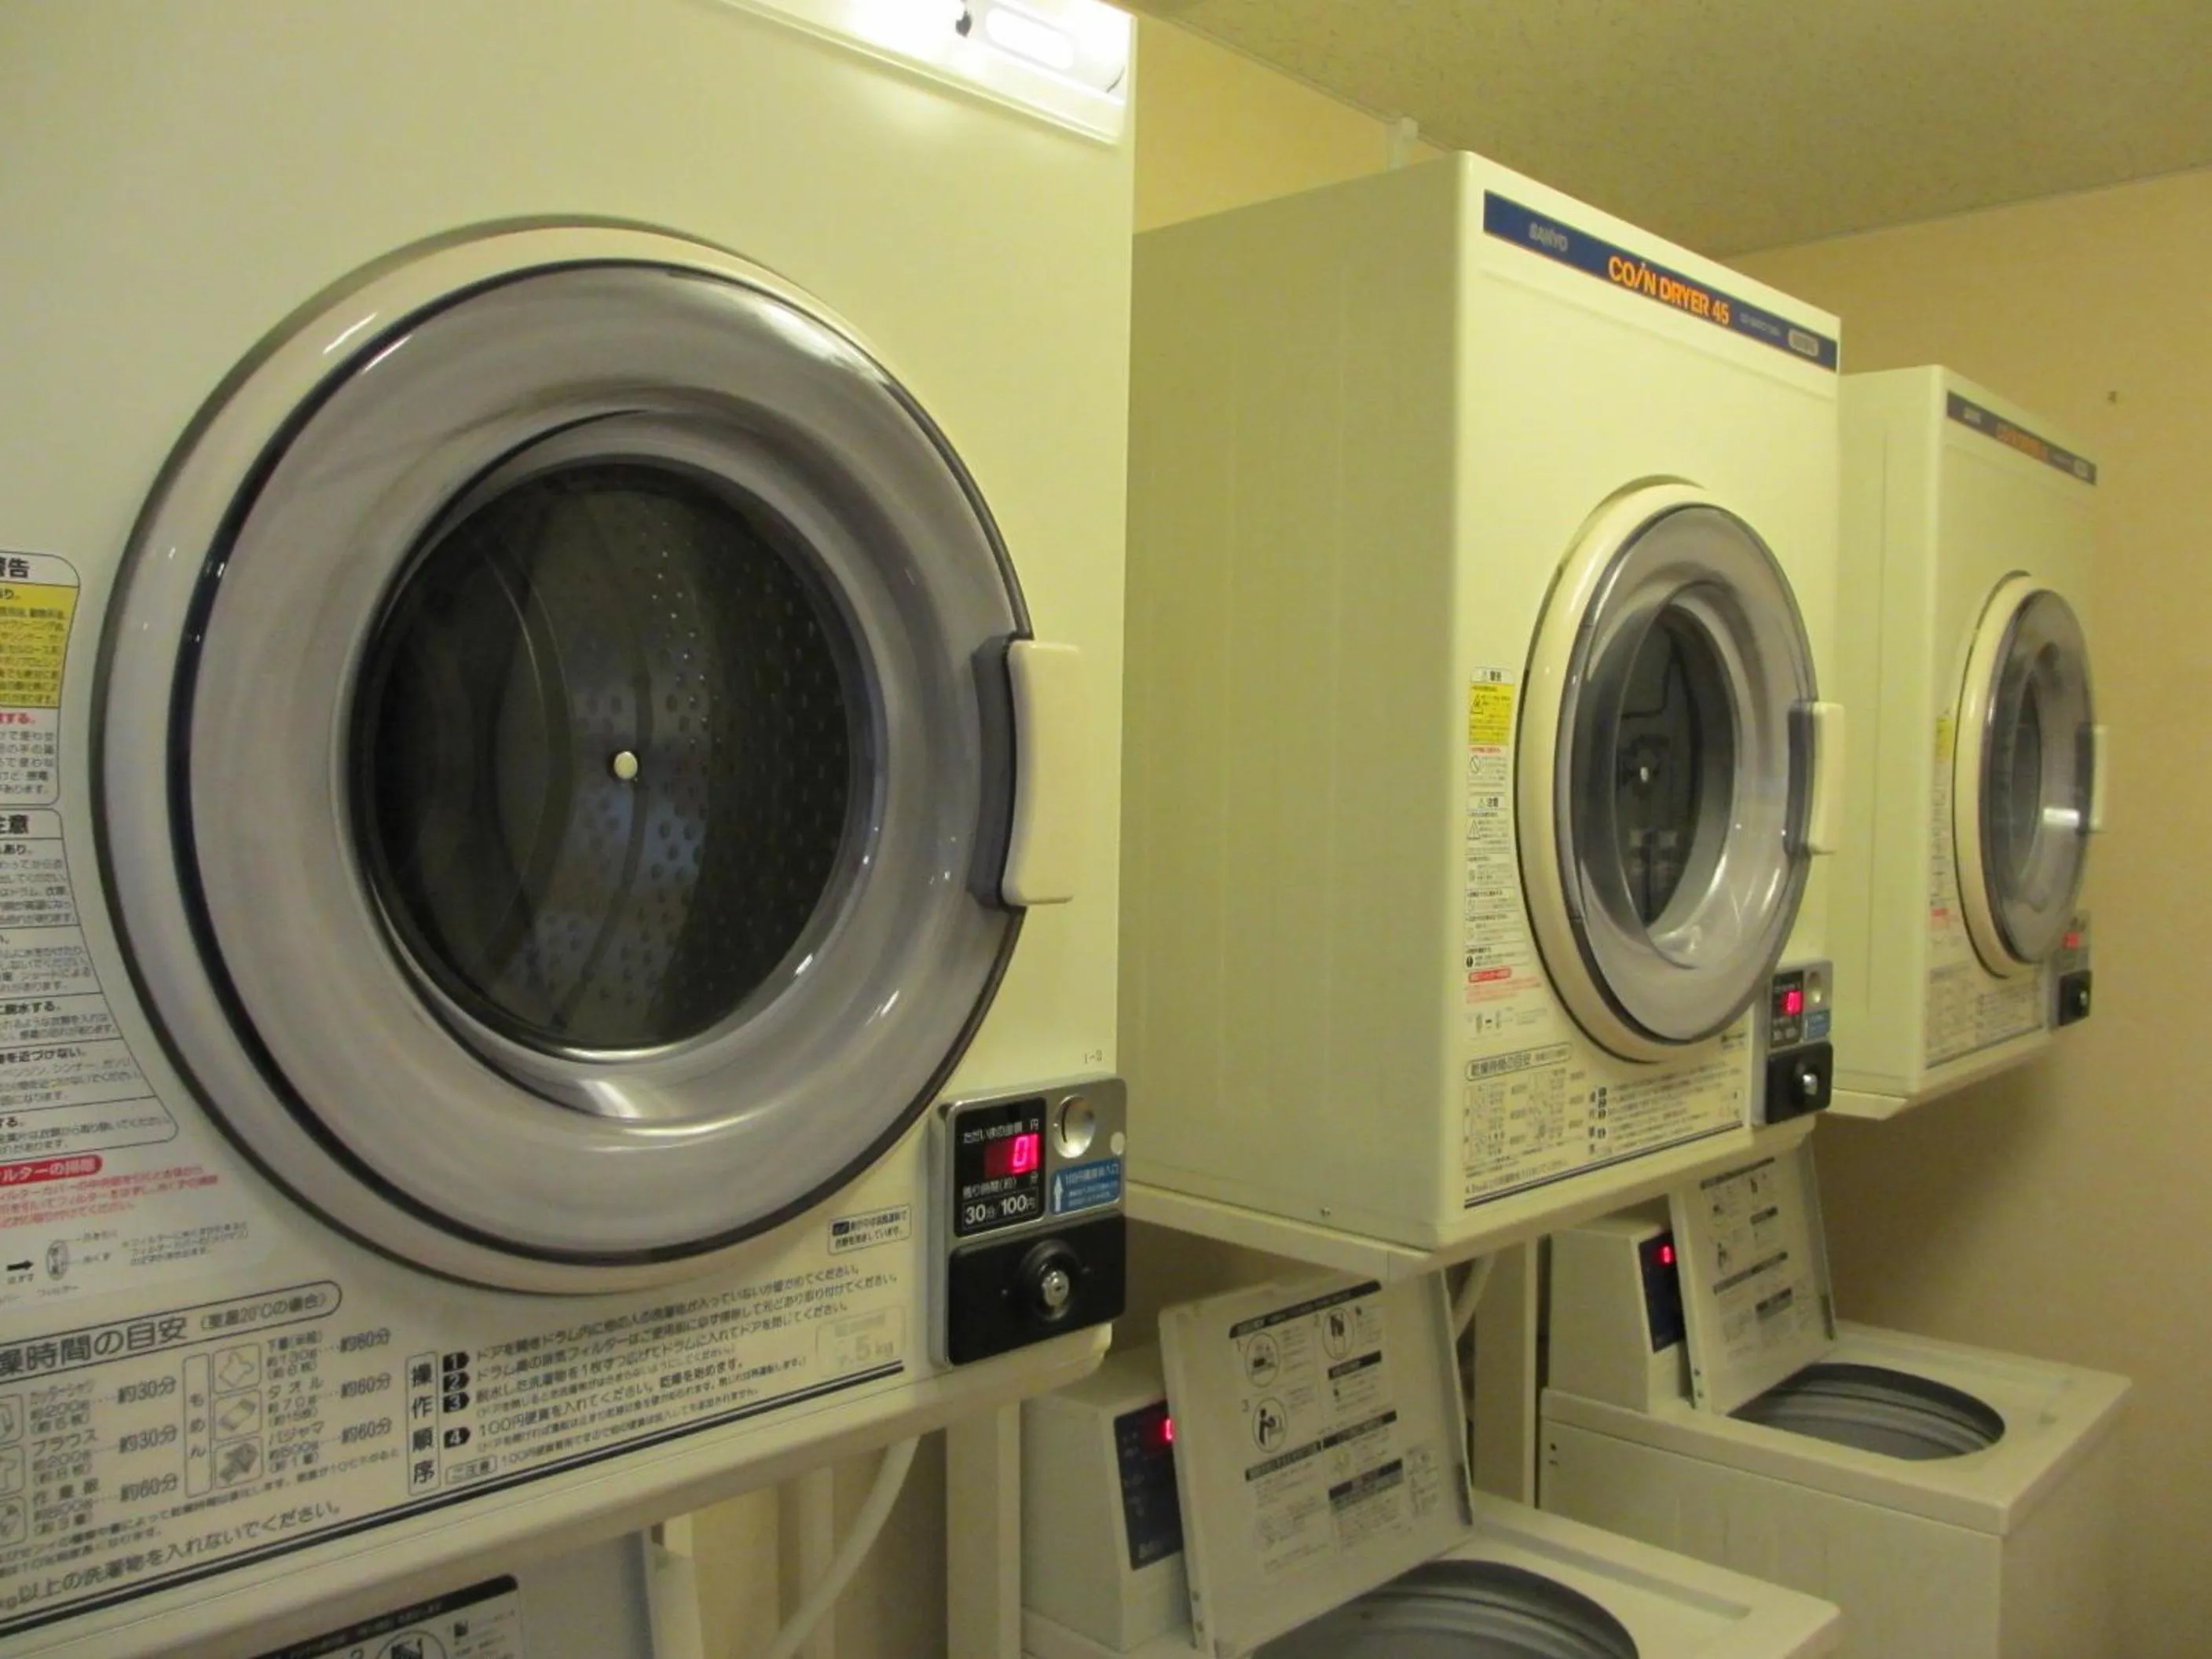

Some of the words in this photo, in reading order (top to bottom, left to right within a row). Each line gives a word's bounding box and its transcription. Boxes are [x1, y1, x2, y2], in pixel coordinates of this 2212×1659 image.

[1529, 222, 1568, 252] SANYO
[1659, 276, 1710, 317] DRYER
[1712, 299, 1729, 324] 45
[118, 1376, 178, 1404] 約30分
[119, 1426, 179, 1454] 約30分
